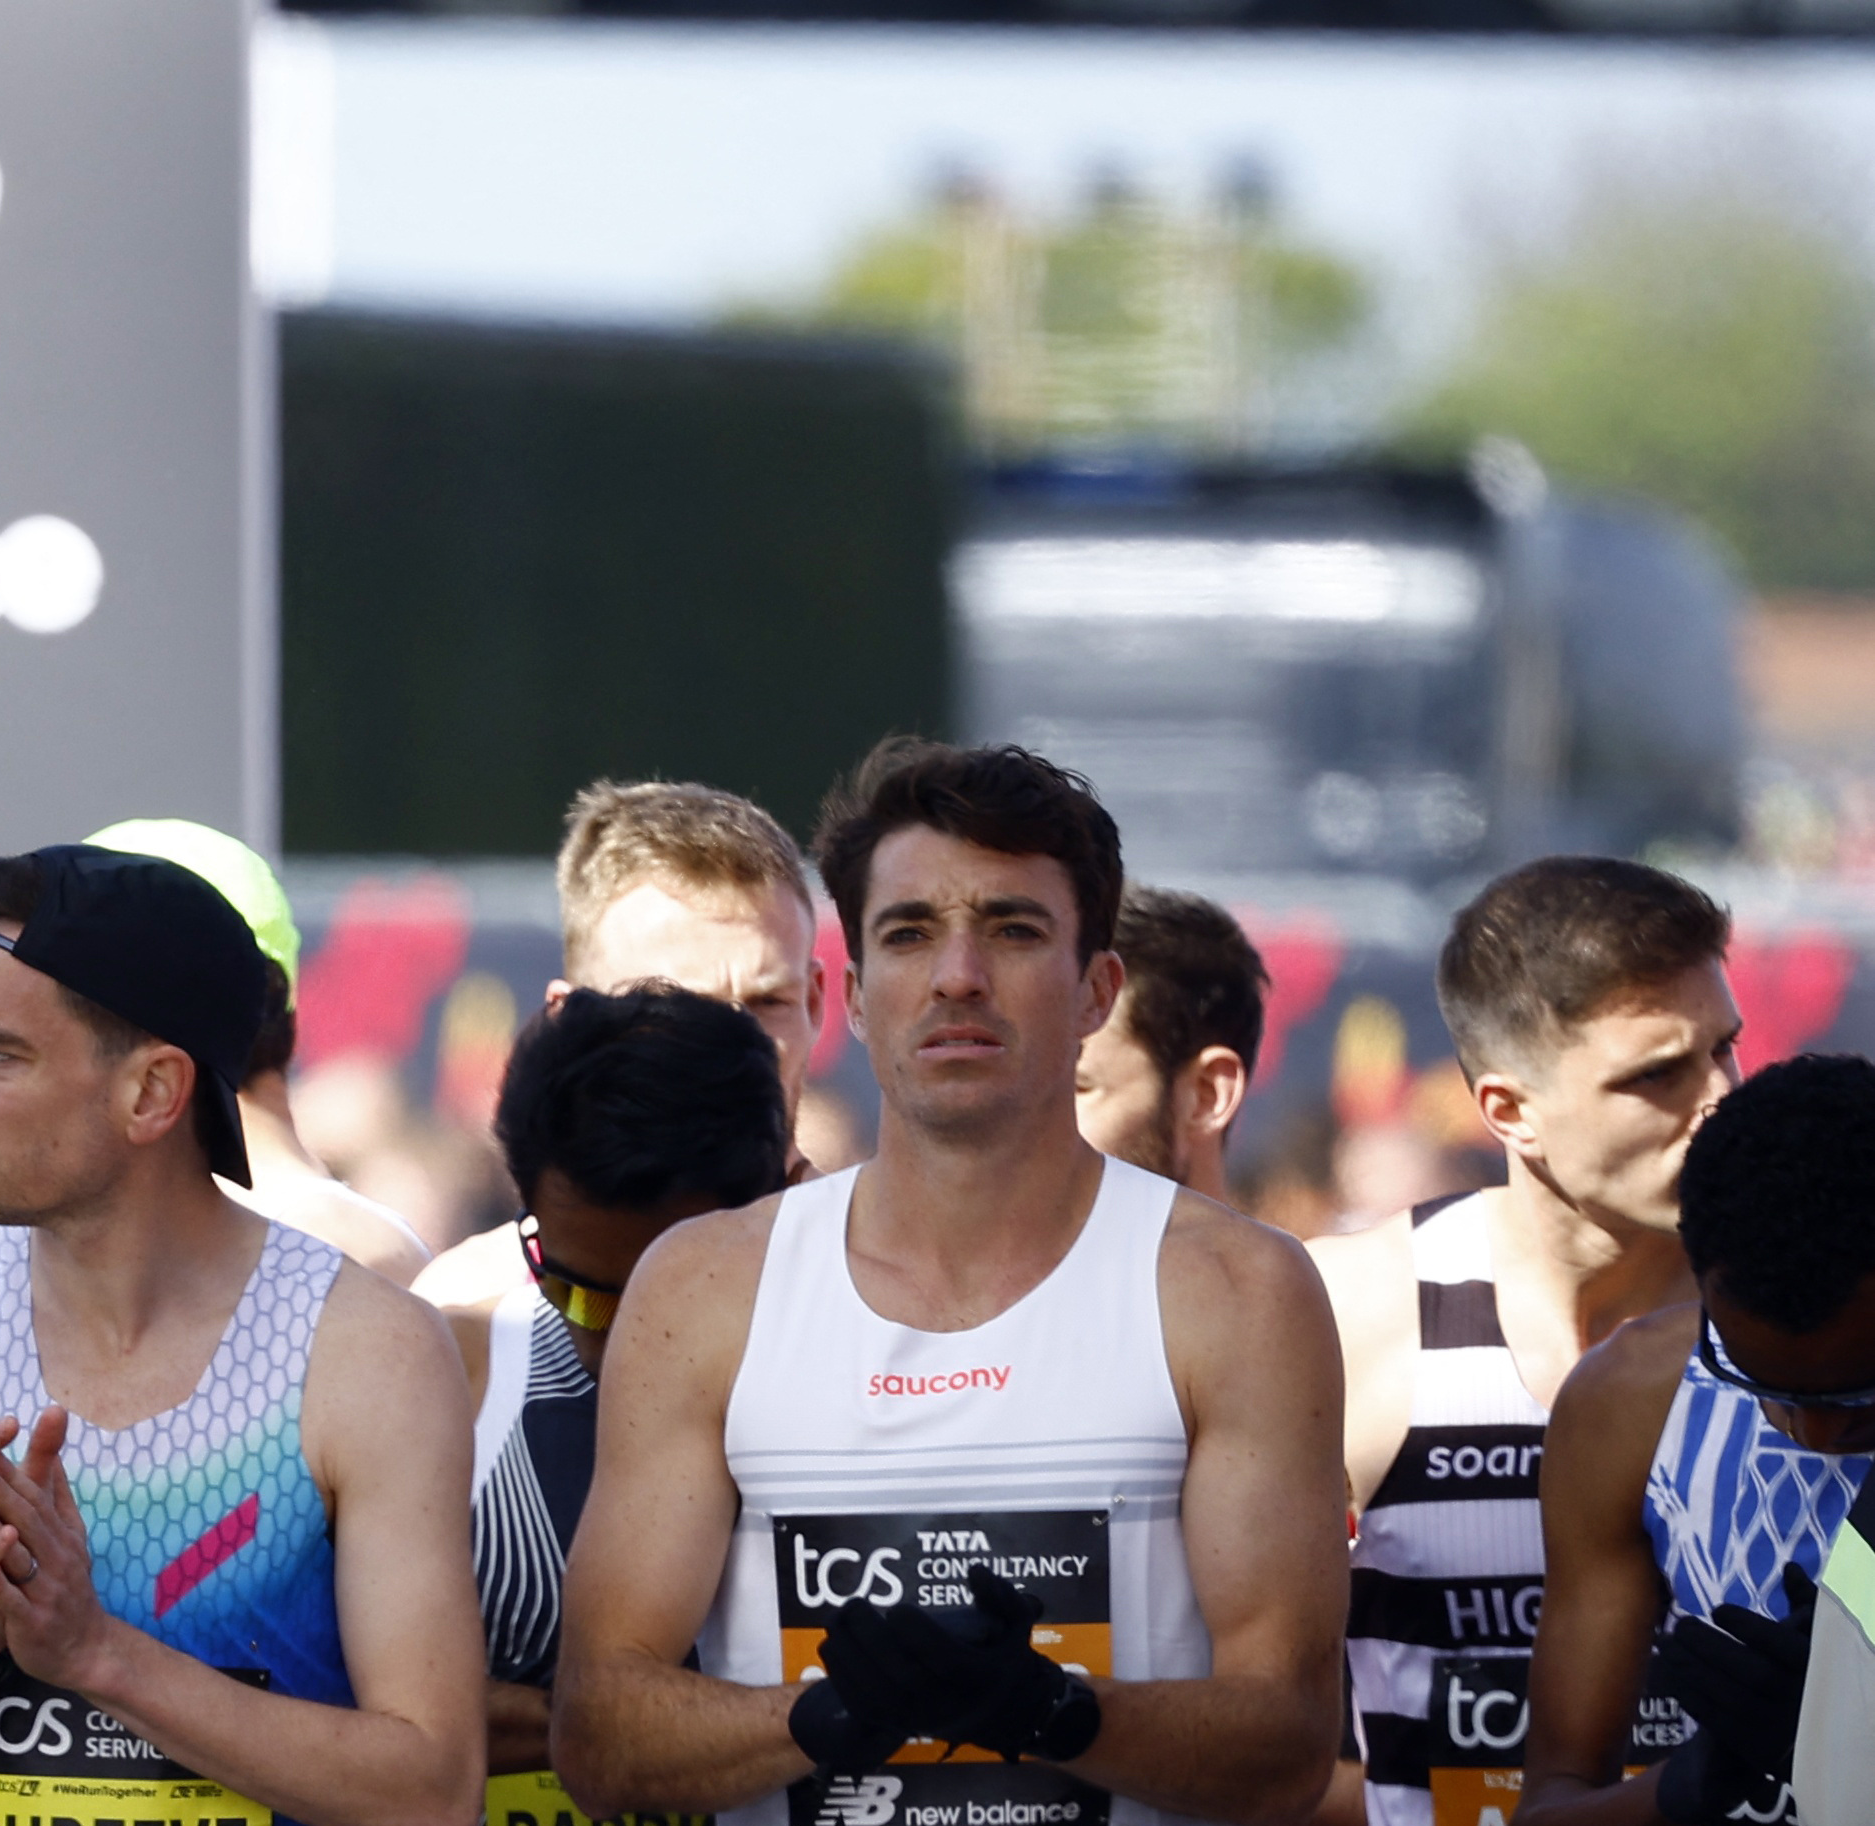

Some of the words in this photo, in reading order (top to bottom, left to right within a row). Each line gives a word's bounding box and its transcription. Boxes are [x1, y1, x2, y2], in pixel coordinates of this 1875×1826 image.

[867, 1365, 1012, 1396] saucony
[1425, 1445, 1545, 1480] soar
[916, 1531, 991, 1552] TATA
[793, 1533, 904, 1608] tcs
[52, 1783, 158, 1800] #WeRunTogether
[814, 1775, 904, 1826] NB
[905, 1805, 961, 1826] new
[966, 1799, 1081, 1826] balance
